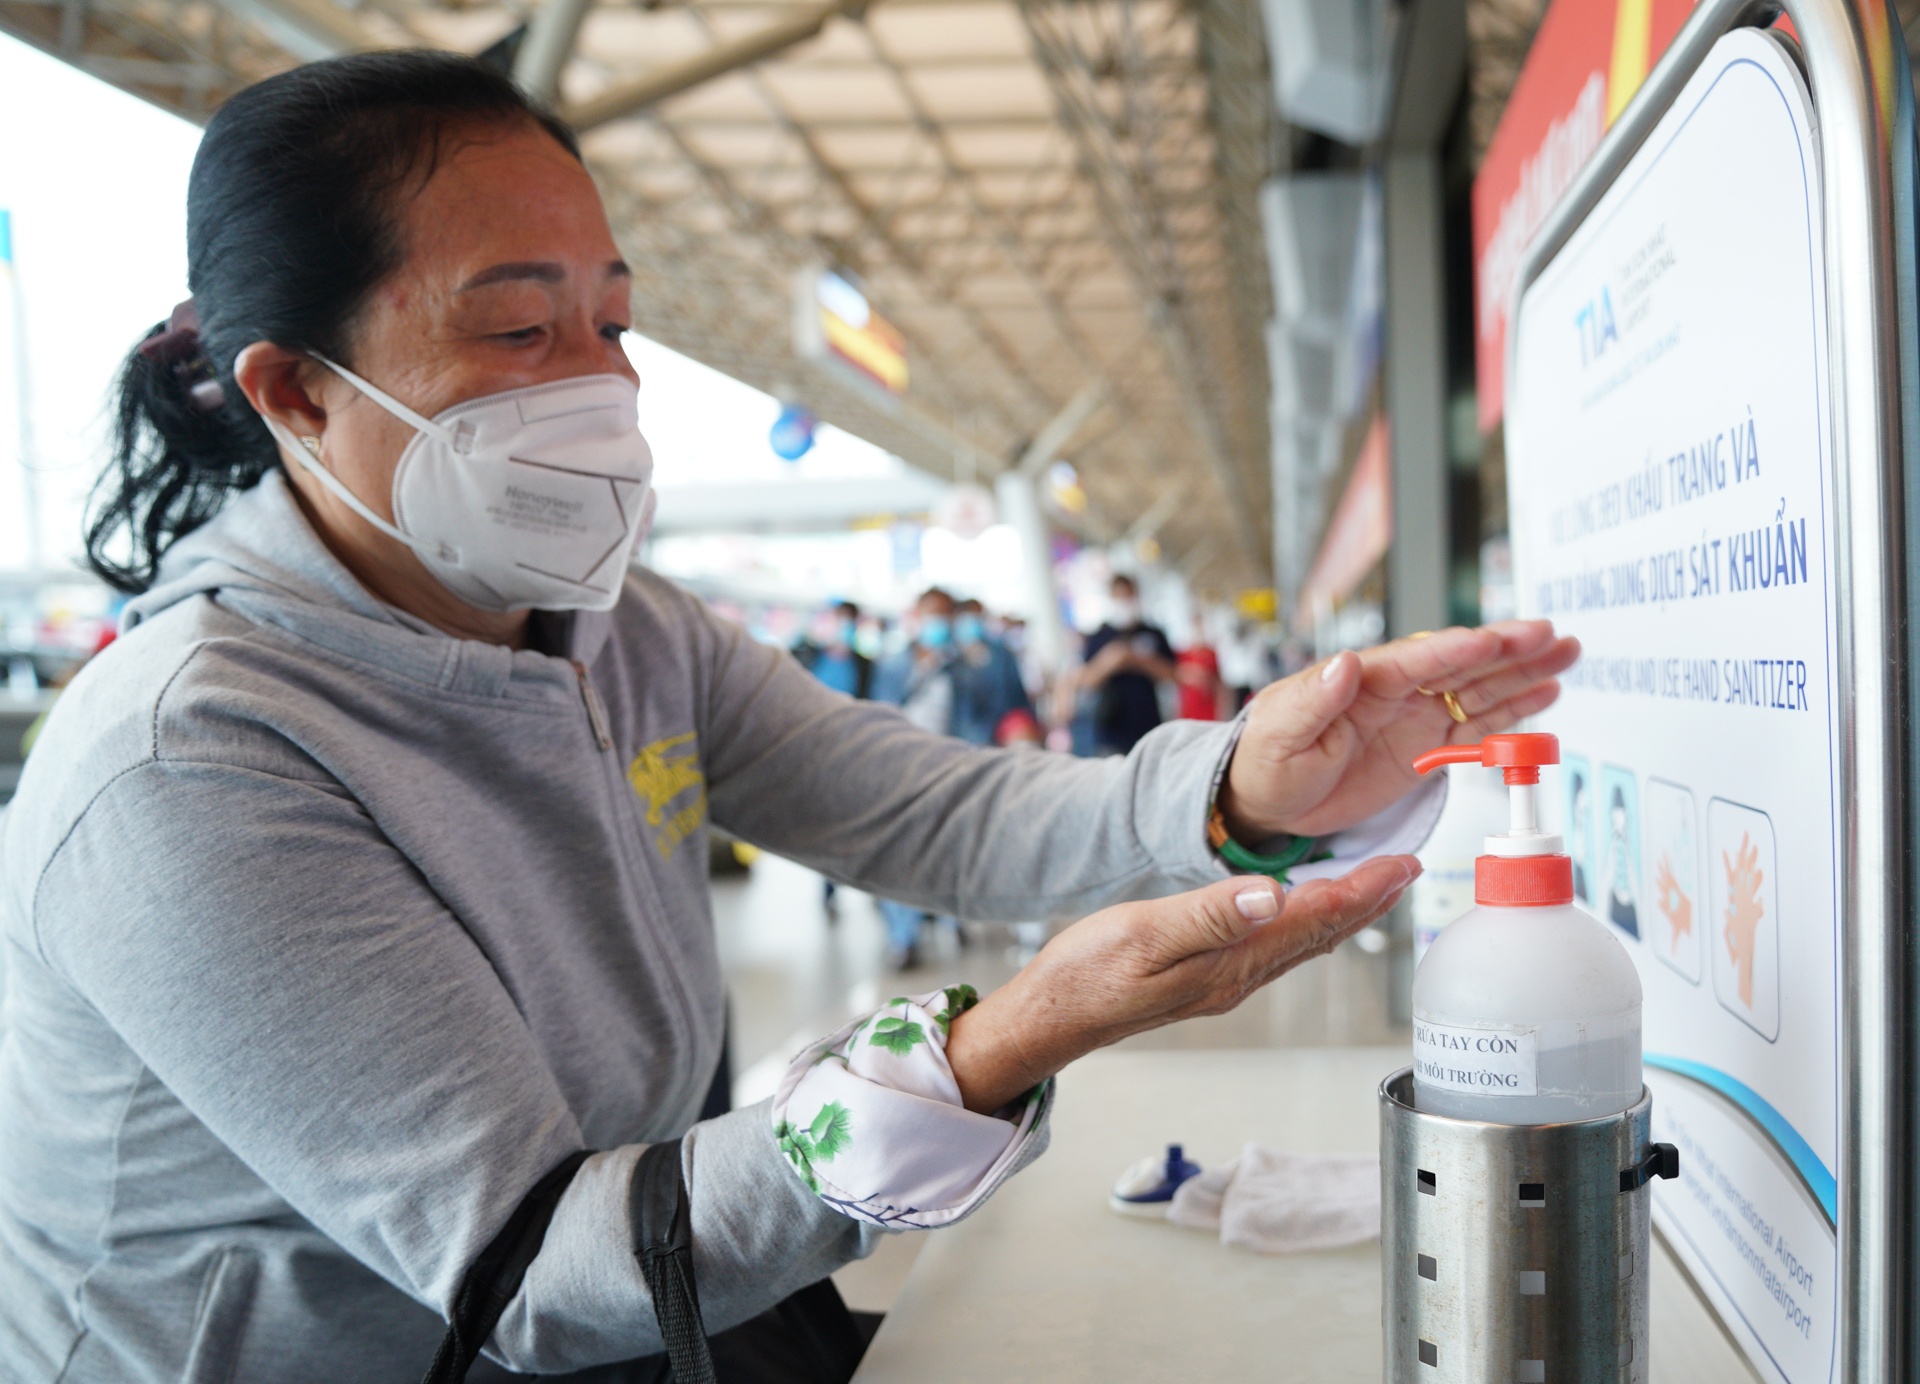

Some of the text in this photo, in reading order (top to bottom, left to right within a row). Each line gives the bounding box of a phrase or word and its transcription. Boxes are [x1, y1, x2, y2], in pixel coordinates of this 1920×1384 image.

[1667, 432, 1726, 506] TRANG
[1731, 404, 1760, 484] VÀ
[1650, 548, 1684, 612] DỊCH
[1689, 528, 1722, 598] SÁT
[1728, 495, 1808, 593] KHUẨN
[1659, 658, 1680, 698] USE
[1683, 660, 1719, 703] HAND
[1723, 659, 1809, 712] SANITIZER
[1439, 1033, 1471, 1051] TAY
[1476, 1034, 1518, 1054] CỒN
[1424, 1062, 1445, 1080] MÔI
[1447, 1069, 1518, 1088] TRƯỜNG
[1774, 1234, 1814, 1297] Airport
